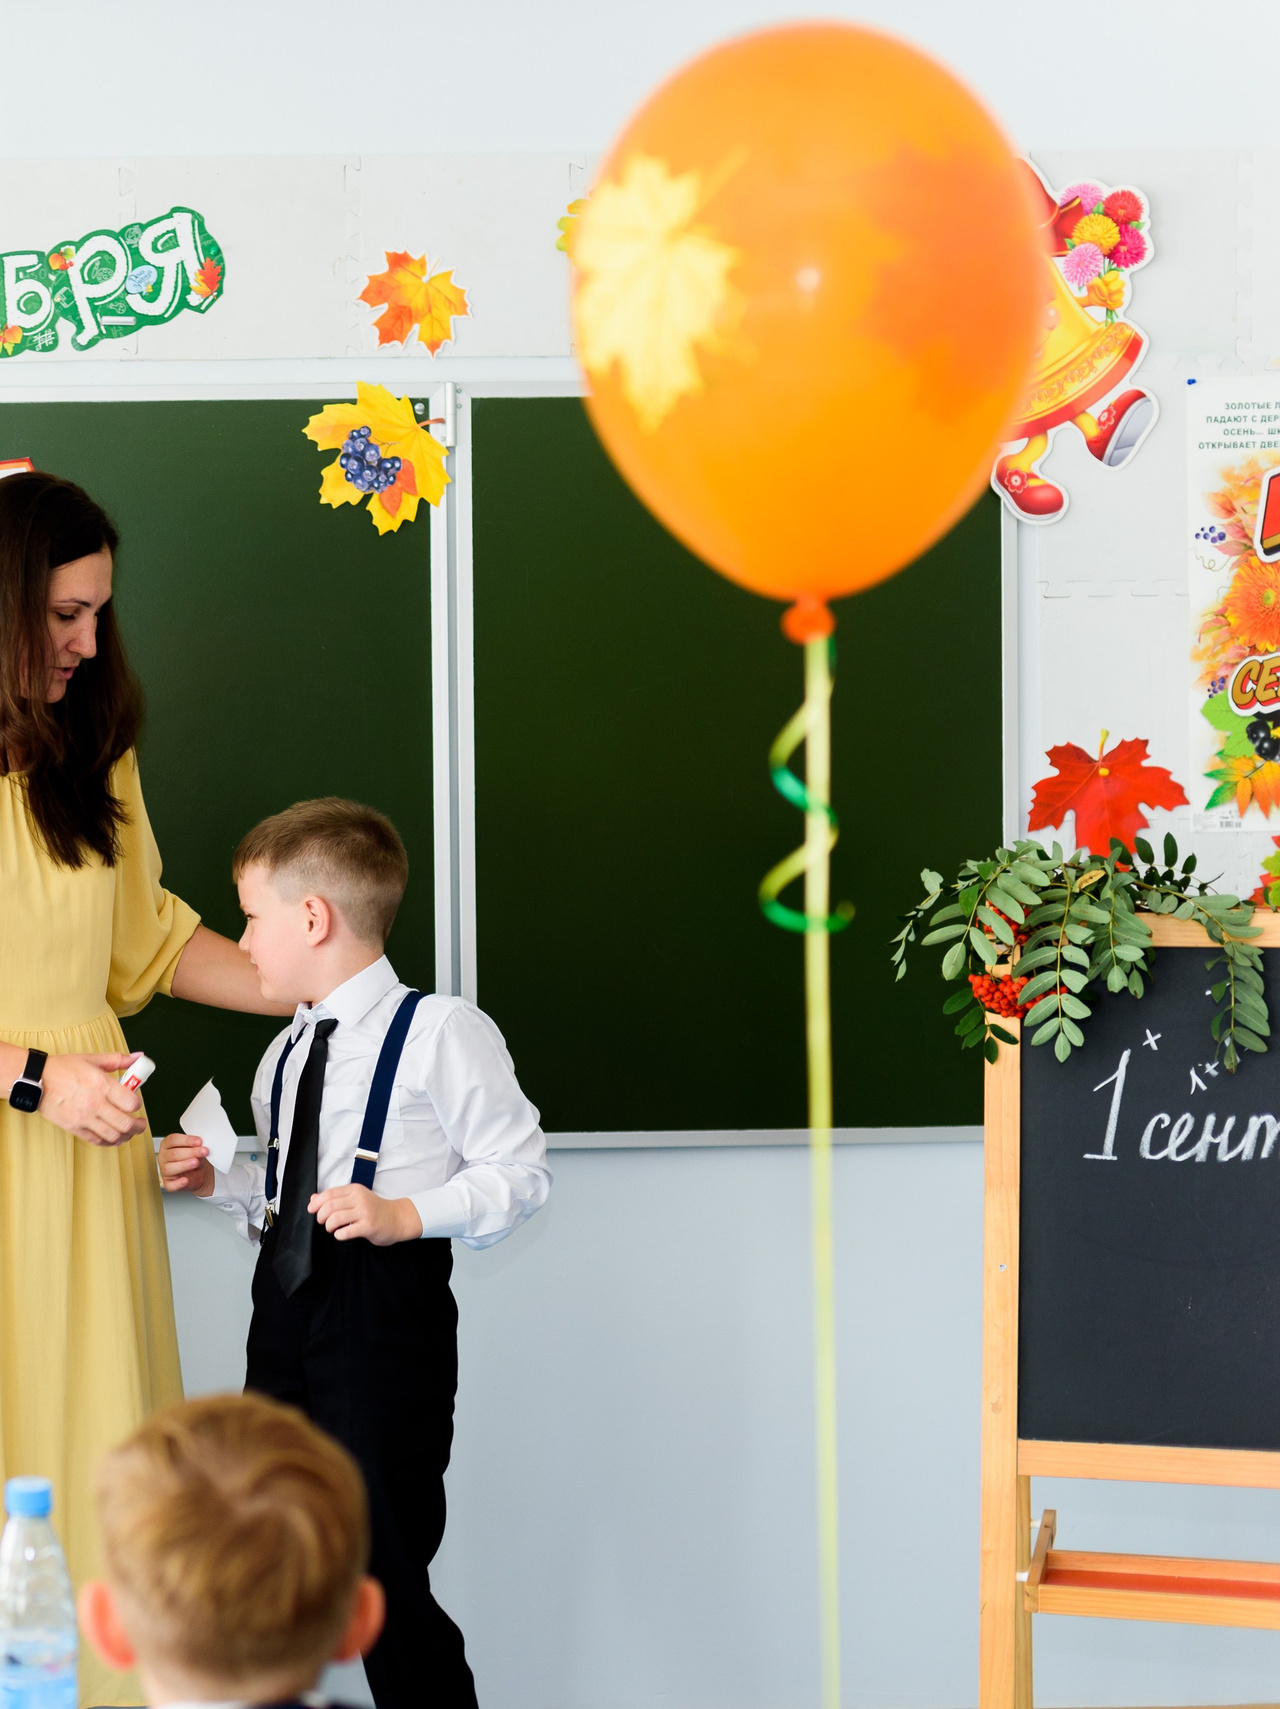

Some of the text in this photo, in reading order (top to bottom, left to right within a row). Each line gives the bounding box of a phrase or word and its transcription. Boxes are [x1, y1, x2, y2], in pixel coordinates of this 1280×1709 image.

[1225, 402, 1272, 410] ЗОЛОТЫЕ
[1206, 415, 1249, 423] ПАДАЮТ
[1260, 415, 1279, 423] ДЕР
[1223, 428, 1264, 436] ОСЕНЬ...
[1198, 441, 1279, 449] ОТКРЫВАЕТ ДВЕ
[1231, 655, 1280, 711] СЕ
[1083, 1048, 1132, 1161] 1
